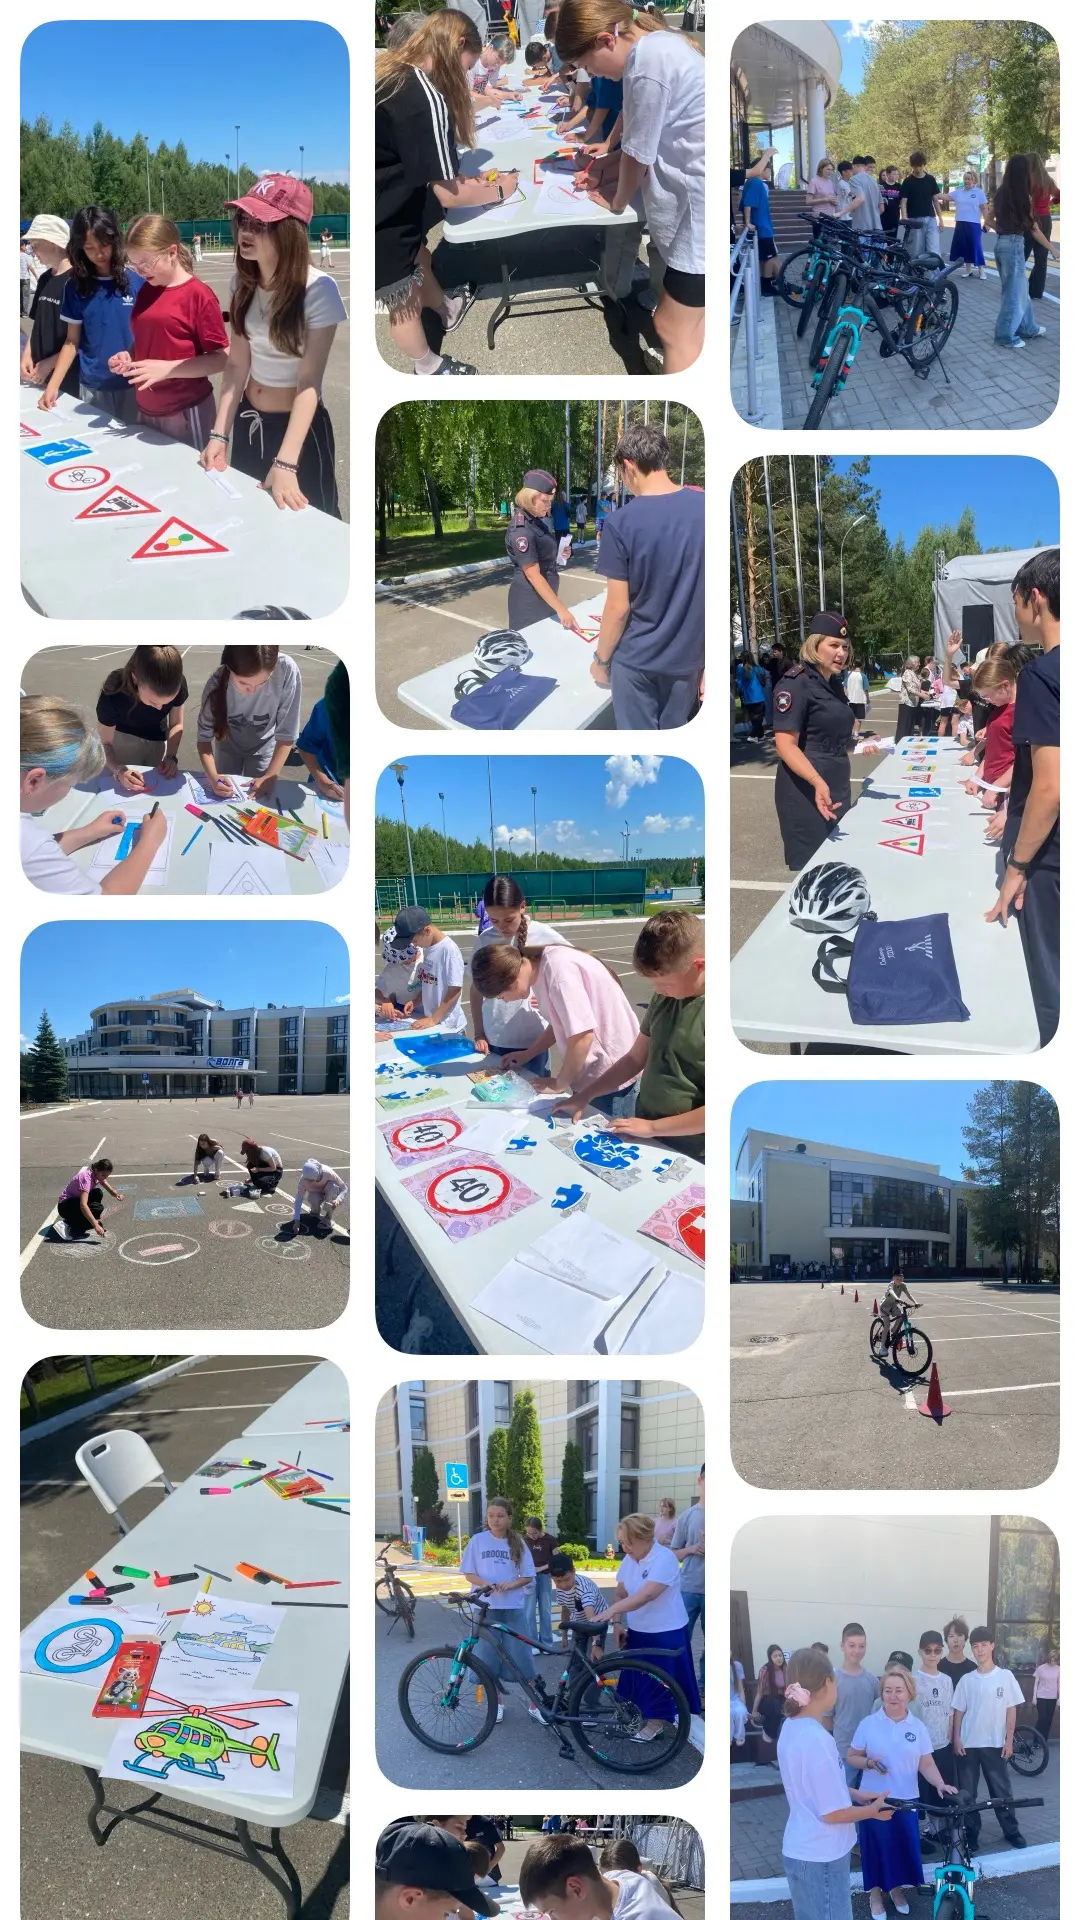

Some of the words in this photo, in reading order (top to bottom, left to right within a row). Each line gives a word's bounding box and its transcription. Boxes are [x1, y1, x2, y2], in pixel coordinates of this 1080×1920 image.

[413, 1124, 444, 1143] 40
[449, 1177, 490, 1203] 40
[481, 1549, 510, 1560] BROOKL
